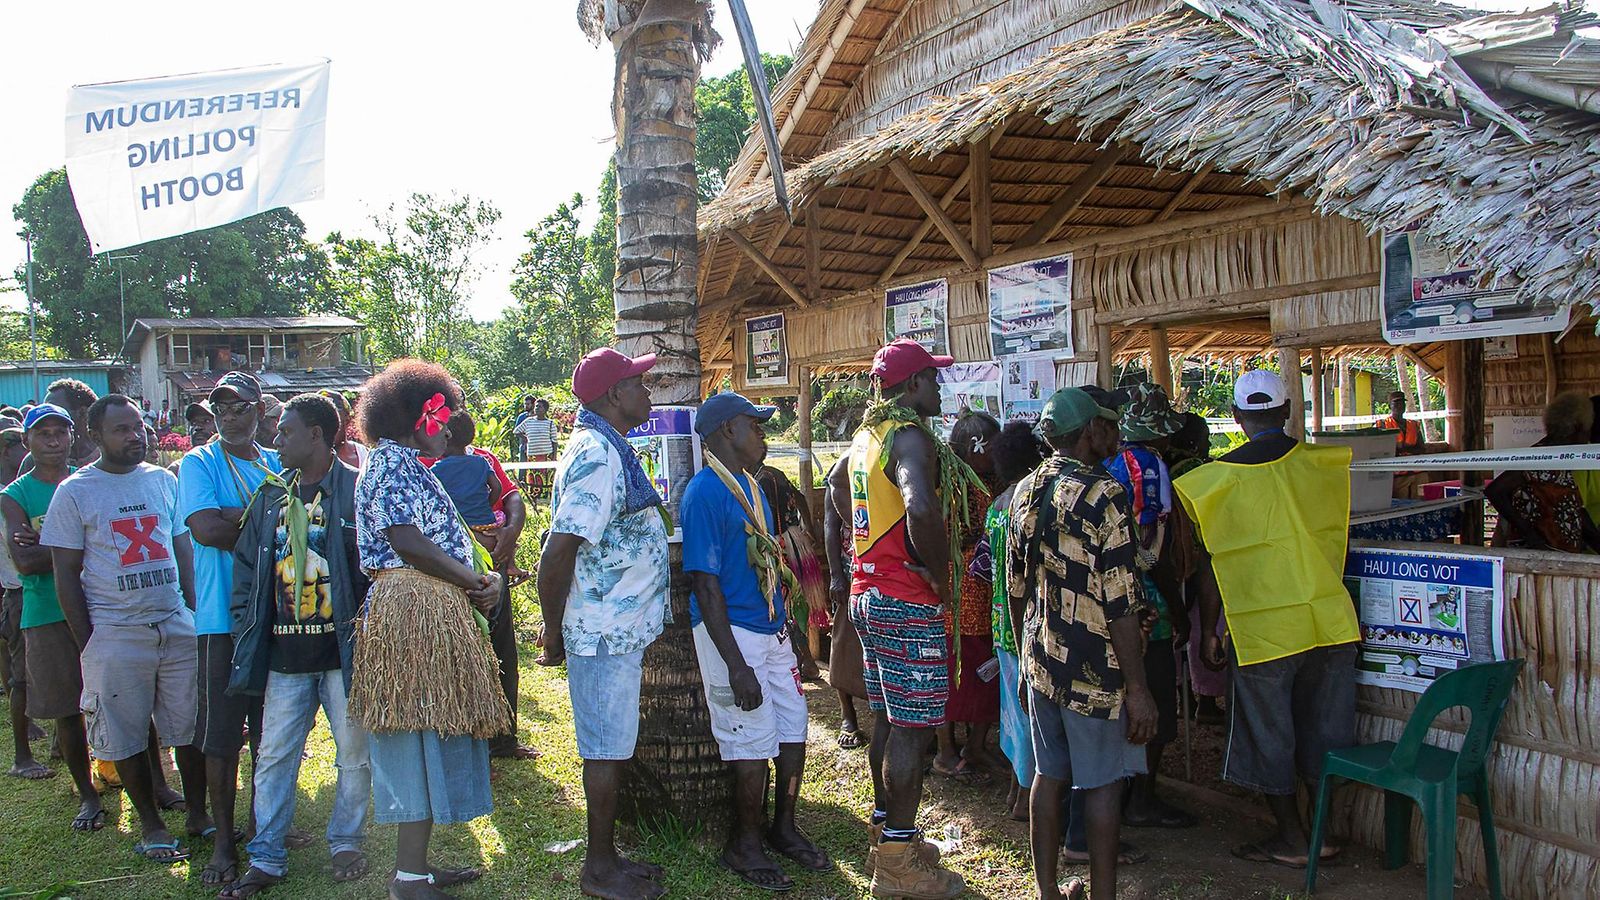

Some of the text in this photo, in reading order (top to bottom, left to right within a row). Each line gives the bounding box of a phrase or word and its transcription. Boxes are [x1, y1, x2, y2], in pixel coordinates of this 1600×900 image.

[118, 503, 147, 514] MARK
[1363, 559, 1460, 581] HAU LONG VOT
[125, 573, 140, 591] THE
[139, 570, 153, 589] BOX
[305, 624, 322, 635] SEE
